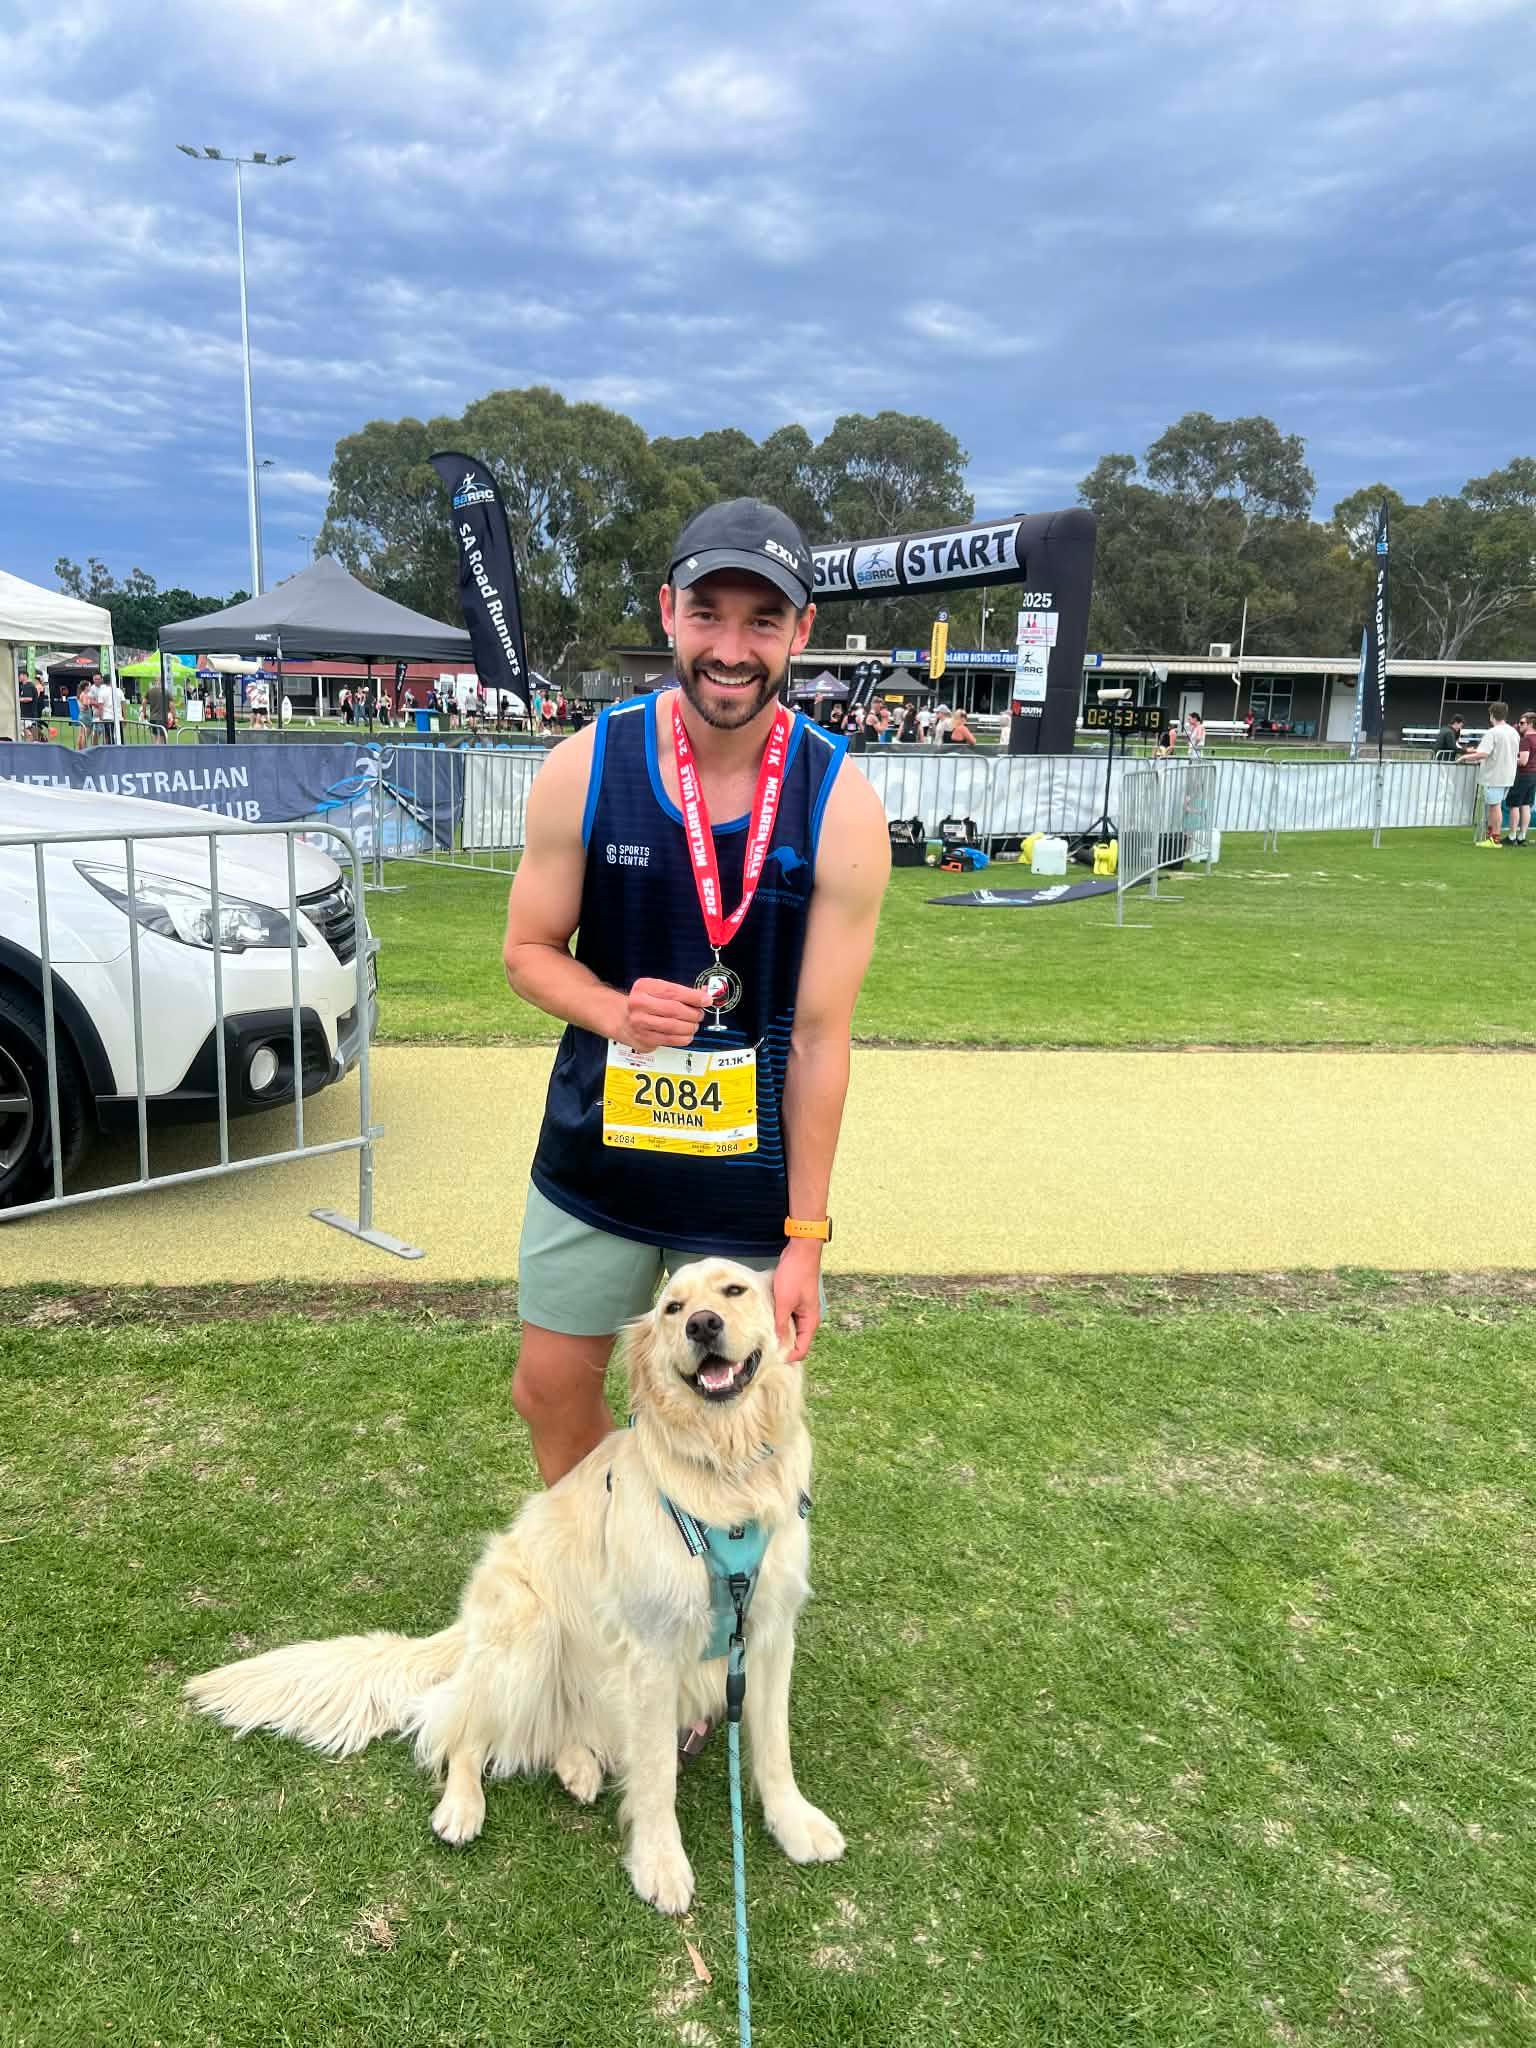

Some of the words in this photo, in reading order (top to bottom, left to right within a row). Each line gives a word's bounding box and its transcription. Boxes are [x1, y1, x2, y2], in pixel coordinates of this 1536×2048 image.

[764, 539, 799, 570] 2XU
[814, 553, 847, 587] SH
[908, 530, 1014, 577] START
[459, 523, 477, 551] SA
[469, 550, 498, 598] Road
[486, 599, 521, 676] Runners
[1087, 709, 1160, 728] 02:53:19
[767, 724, 785, 766] 21.1K
[81, 766, 249, 796] AUSTRALIAN
[680, 764, 695, 800] VALE
[757, 776, 779, 842] MCLAREN
[685, 800, 707, 867] MCLAREN
[619, 845, 650, 857] SPORTS
[619, 855, 649, 867] CENTRE
[749, 843, 765, 879] VALE
[702, 878, 717, 915] 2025
[718, 1056, 744, 1067] 21.1K
[634, 1073, 722, 1112] 2084
[653, 1110, 703, 1127] NATHAN
[614, 1135, 636, 1144] 2084
[716, 1143, 738, 1153] 2084
